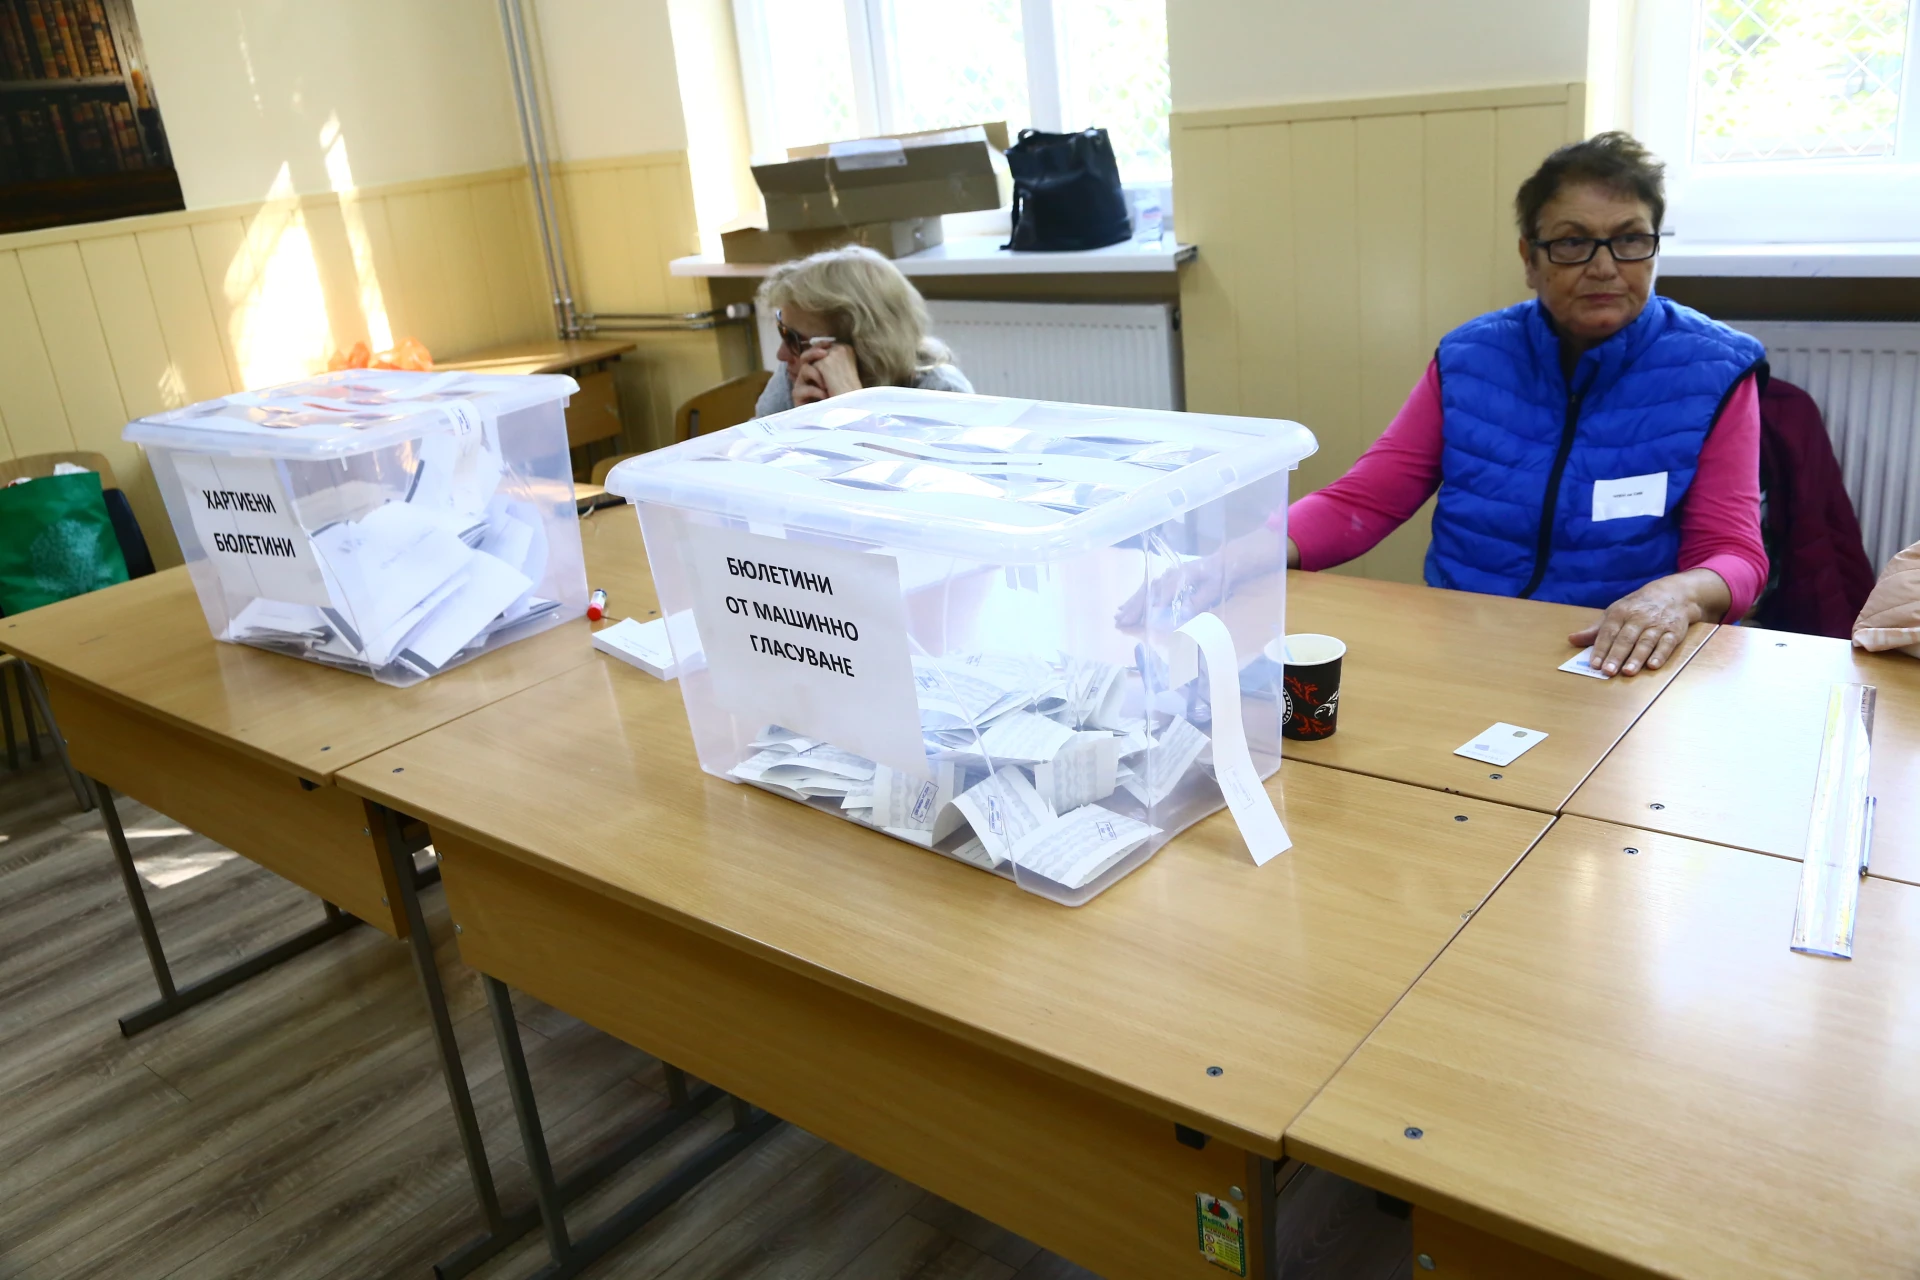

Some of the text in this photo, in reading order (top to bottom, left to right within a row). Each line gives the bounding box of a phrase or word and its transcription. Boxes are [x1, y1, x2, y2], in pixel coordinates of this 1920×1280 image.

[203, 490, 276, 513] ХАРТИЕНИ
[214, 533, 296, 557] БЮЛЕТИНИ
[727, 557, 833, 595] БЮЛЕТИНИ
[726, 596, 859, 641] ОТ МАШИННО
[750, 634, 855, 677] ГЛАСУВАНЕ
